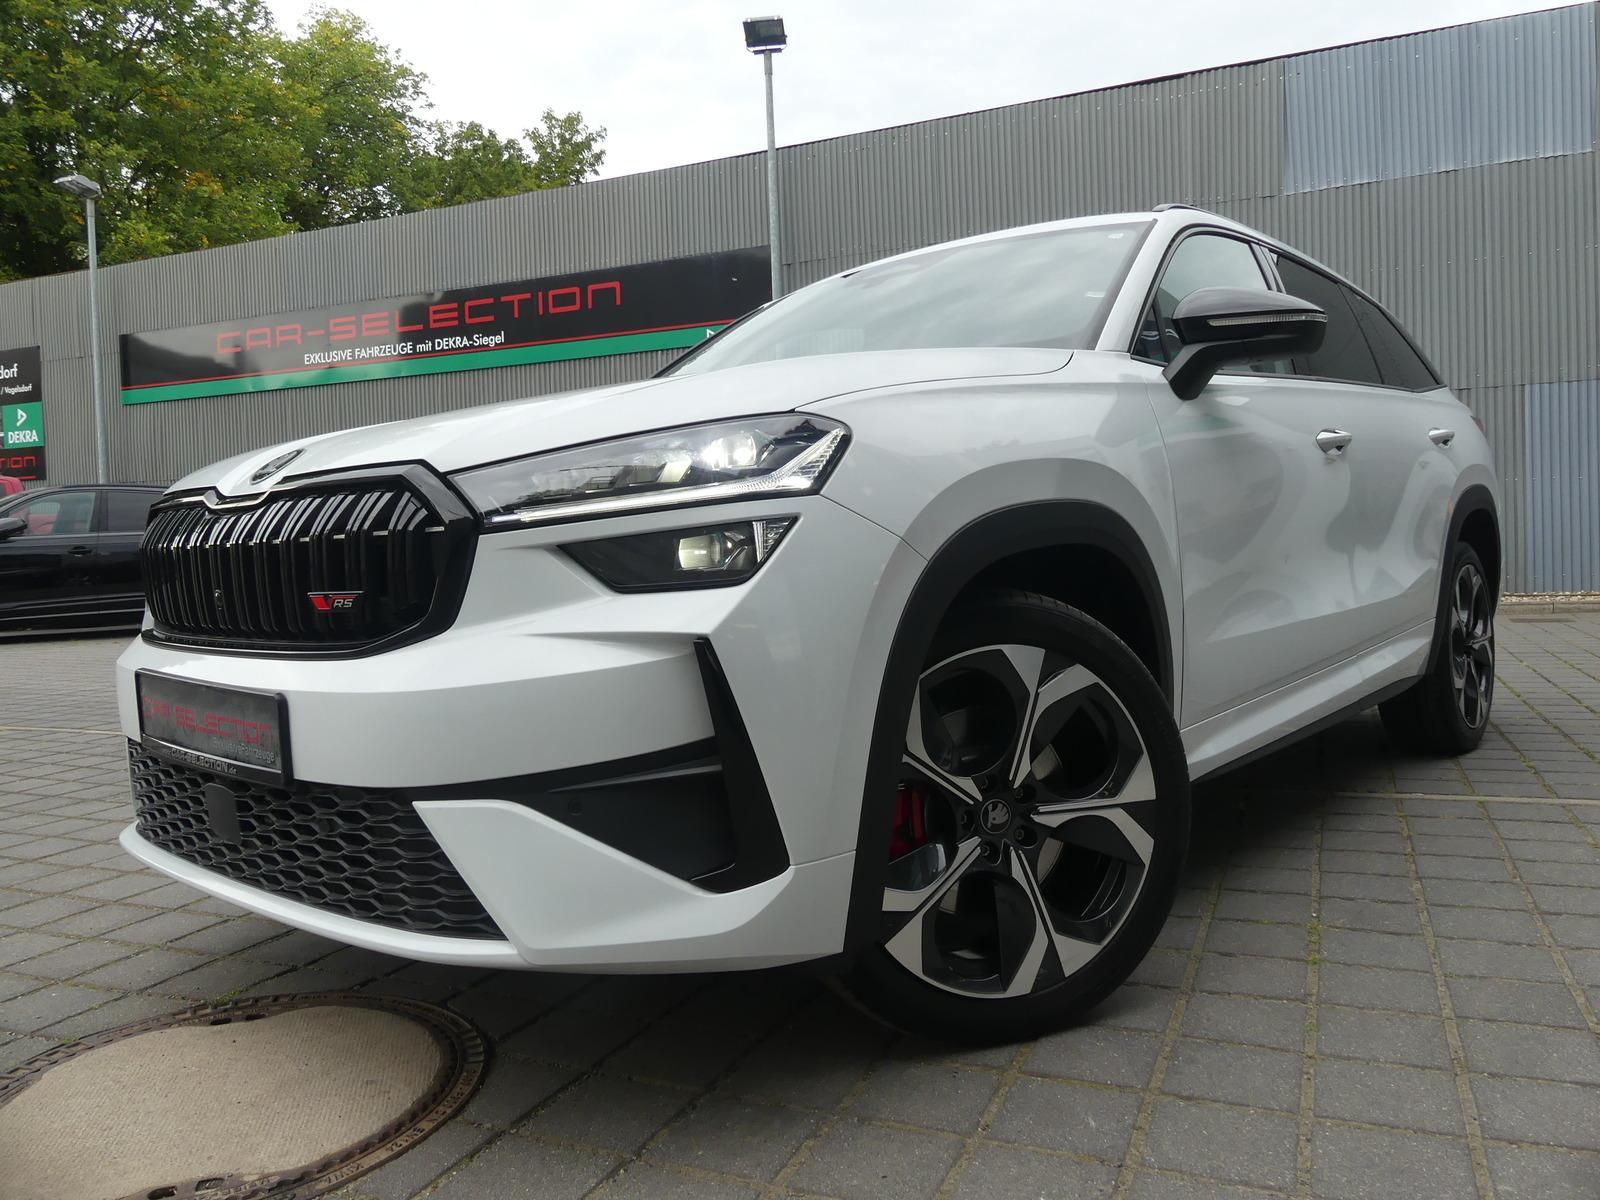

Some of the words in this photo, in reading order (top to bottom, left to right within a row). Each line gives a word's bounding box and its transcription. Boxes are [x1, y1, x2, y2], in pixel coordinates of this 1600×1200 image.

[216, 280, 622, 355] CAR-SELECTION
[304, 348, 353, 365] EXKLUSIVE
[354, 342, 413, 360] FAHRZEUGE
[416, 340, 433, 353] mit
[435, 330, 505, 351] DEKRA-Siegel
[8, 430, 39, 444] DEKRA
